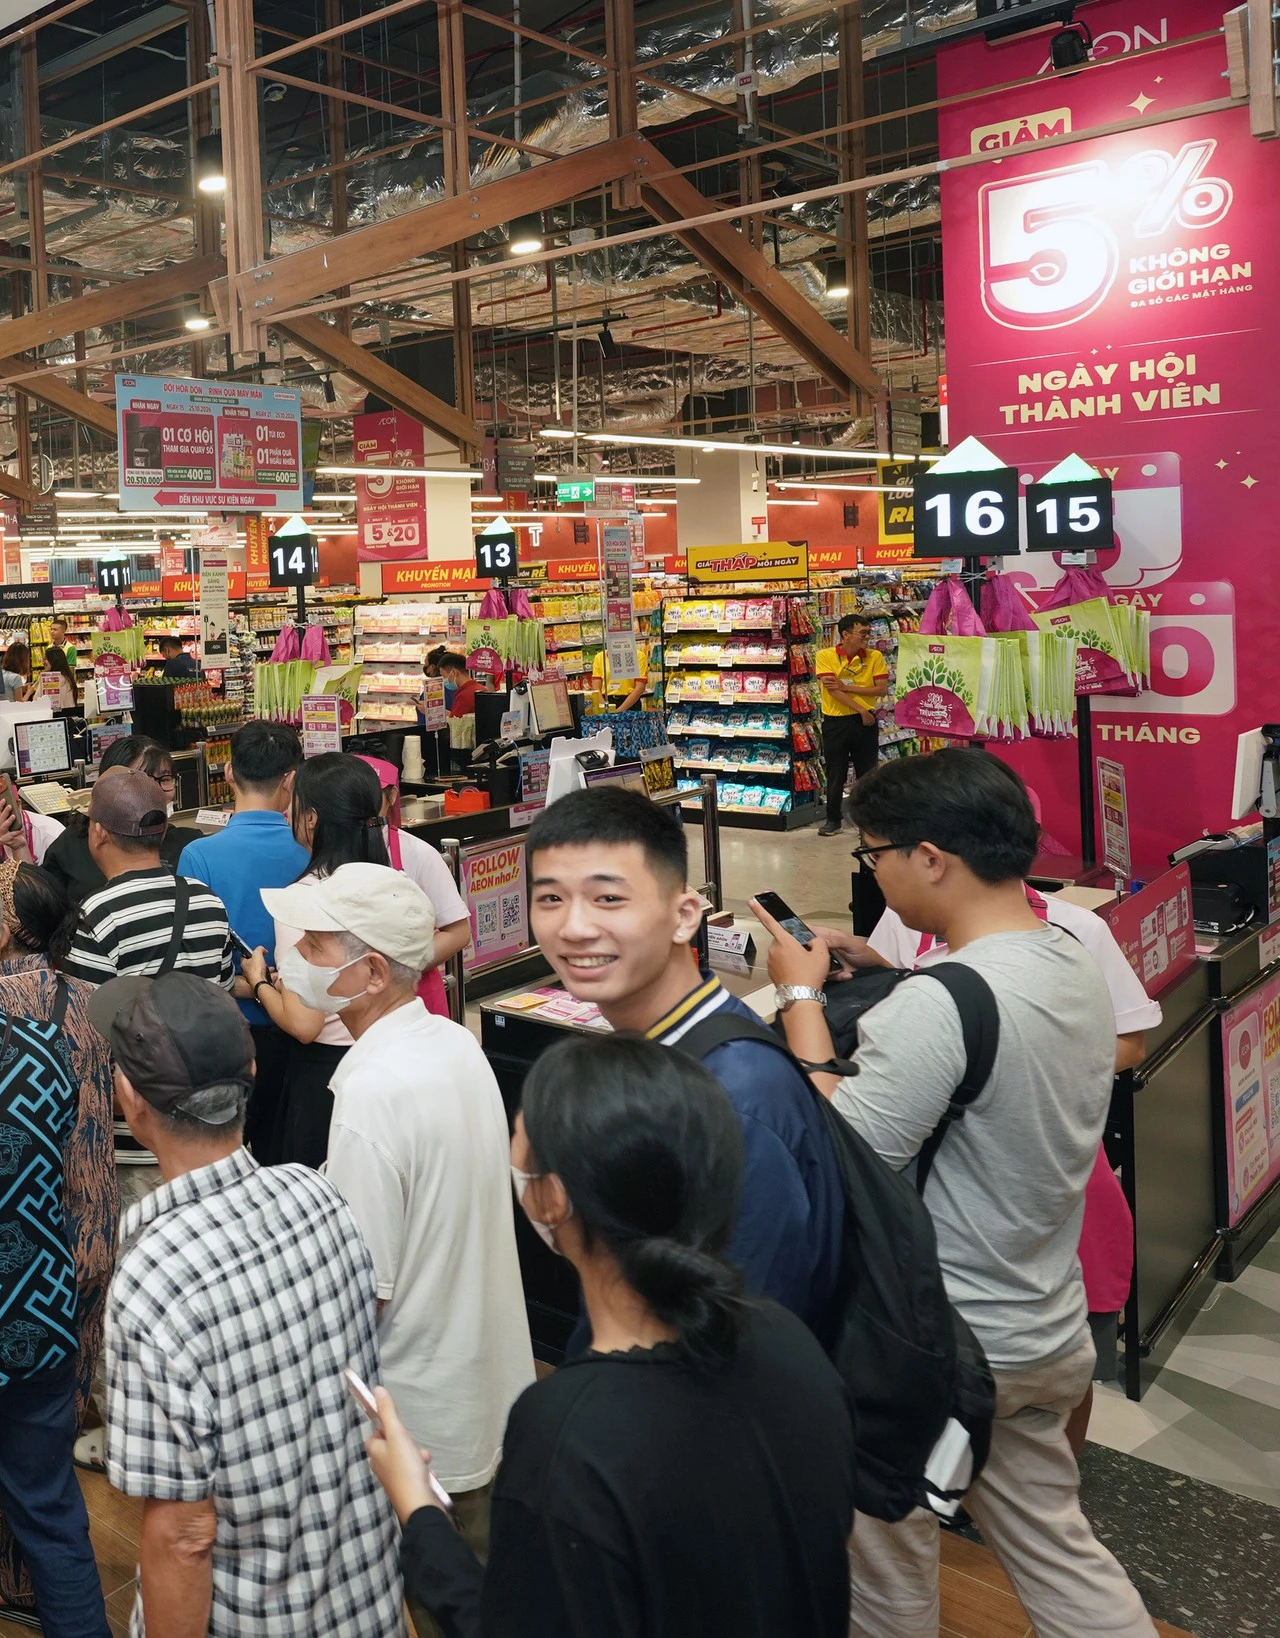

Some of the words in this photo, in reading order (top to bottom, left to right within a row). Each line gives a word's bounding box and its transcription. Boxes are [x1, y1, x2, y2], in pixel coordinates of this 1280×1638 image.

[1129, 243, 1231, 274] KHÔNG
[1127, 269, 1184, 295] GIỚI
[1190, 261, 1252, 287] HẠN
[1148, 295, 1163, 306] SỐ
[1165, 293, 1190, 303] CÁC
[1192, 289, 1217, 299] MẶT
[1219, 284, 1253, 296] HÀNG
[1018, 362, 1119, 395] NGÀY
[1129, 351, 1196, 383] HỘI
[999, 394, 1121, 426] THÀNH
[1131, 379, 1221, 412] VIÊN
[163, 427, 174, 442] 01
[194, 426, 213, 445] HỘI
[256, 425, 269, 441] 01
[163, 445, 179, 453] THAM
[180, 445, 190, 454] GIA
[190, 446, 205, 454] QUAY
[206, 444, 214, 454] SỐ
[256, 448, 269, 464] 01
[187, 468, 203, 480] 400
[275, 471, 290, 483] 600
[178, 492, 191, 504] ĐẾN
[191, 495, 204, 504] KHU
[240, 496, 255, 505] NGAY
[387, 502, 406, 510] THÀNH
[924, 490, 1005, 538] 16
[1036, 496, 1101, 535] 15
[247, 519, 259, 565] KHUYẾN
[260, 517, 268, 564] PROMOTION
[372, 525, 383, 541] 5
[394, 526, 416, 542] 20
[272, 546, 306, 575] 14
[480, 543, 511, 568] 13
[697, 560, 711, 570] GIÁ
[710, 552, 757, 572] THẤP
[757, 559, 773, 568] MỖI
[774, 557, 798, 567] NGÀY
[820, 551, 842, 564] MẠI
[876, 546, 913, 559] KHUYẾ
[100, 567, 119, 587] 11
[122, 566, 131, 586] 11
[396, 565, 454, 583] KHUYẾN
[456, 567, 477, 583] MẠI
[531, 565, 547, 578] RẺ
[558, 561, 596, 574] KHUYẾN
[132, 583, 149, 592] HUYẾN
[174, 580, 200, 592] KHUY
[247, 577, 267, 587] HUYẾN
[1114, 591, 1162, 608] GÀY
[1096, 722, 1201, 744] THÁNG
[471, 846, 520, 879] FOLLOW
[470, 876, 494, 894] AEON
[494, 866, 521, 885] nha!!
